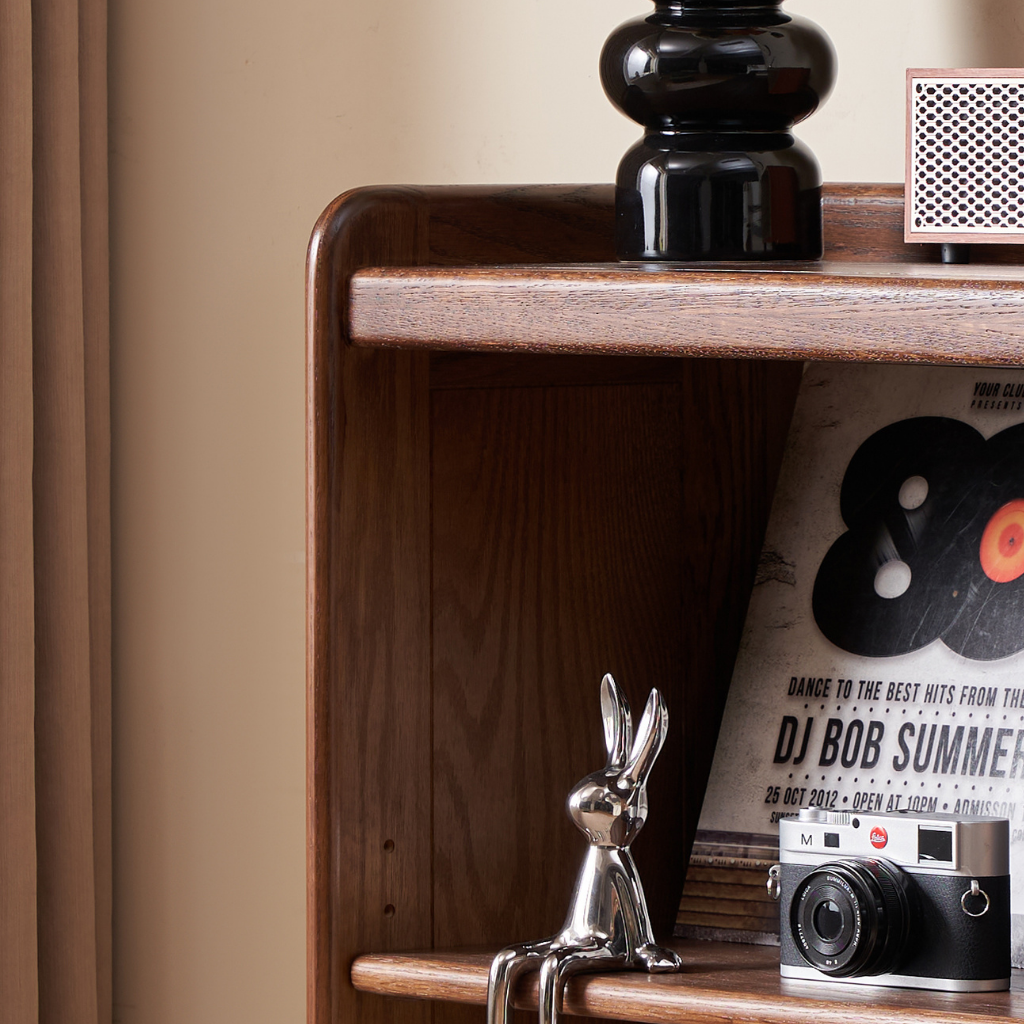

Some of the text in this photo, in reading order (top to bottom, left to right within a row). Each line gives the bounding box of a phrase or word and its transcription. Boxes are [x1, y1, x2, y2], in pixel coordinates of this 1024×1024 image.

[973, 382, 1000, 397] YOUR
[970, 400, 1022, 411] PRESENTS
[787, 676, 832, 698] DANCE
[836, 678, 853, 699] TO
[858, 680, 883, 701] THE
[886, 682, 921, 703] BEST
[925, 684, 956, 704] HITS
[959, 685, 998, 708] FROM
[773, 715, 814, 765] DJ
[818, 718, 885, 770] BOB
[765, 786, 781, 804] 25
[783, 787, 807, 806] OCT
[808, 790, 839, 808] 2012
[852, 791, 884, 811] OPEN
[886, 796, 902, 811] AT
[906, 797, 938, 812] 10PM
[801, 833, 813, 846] M
